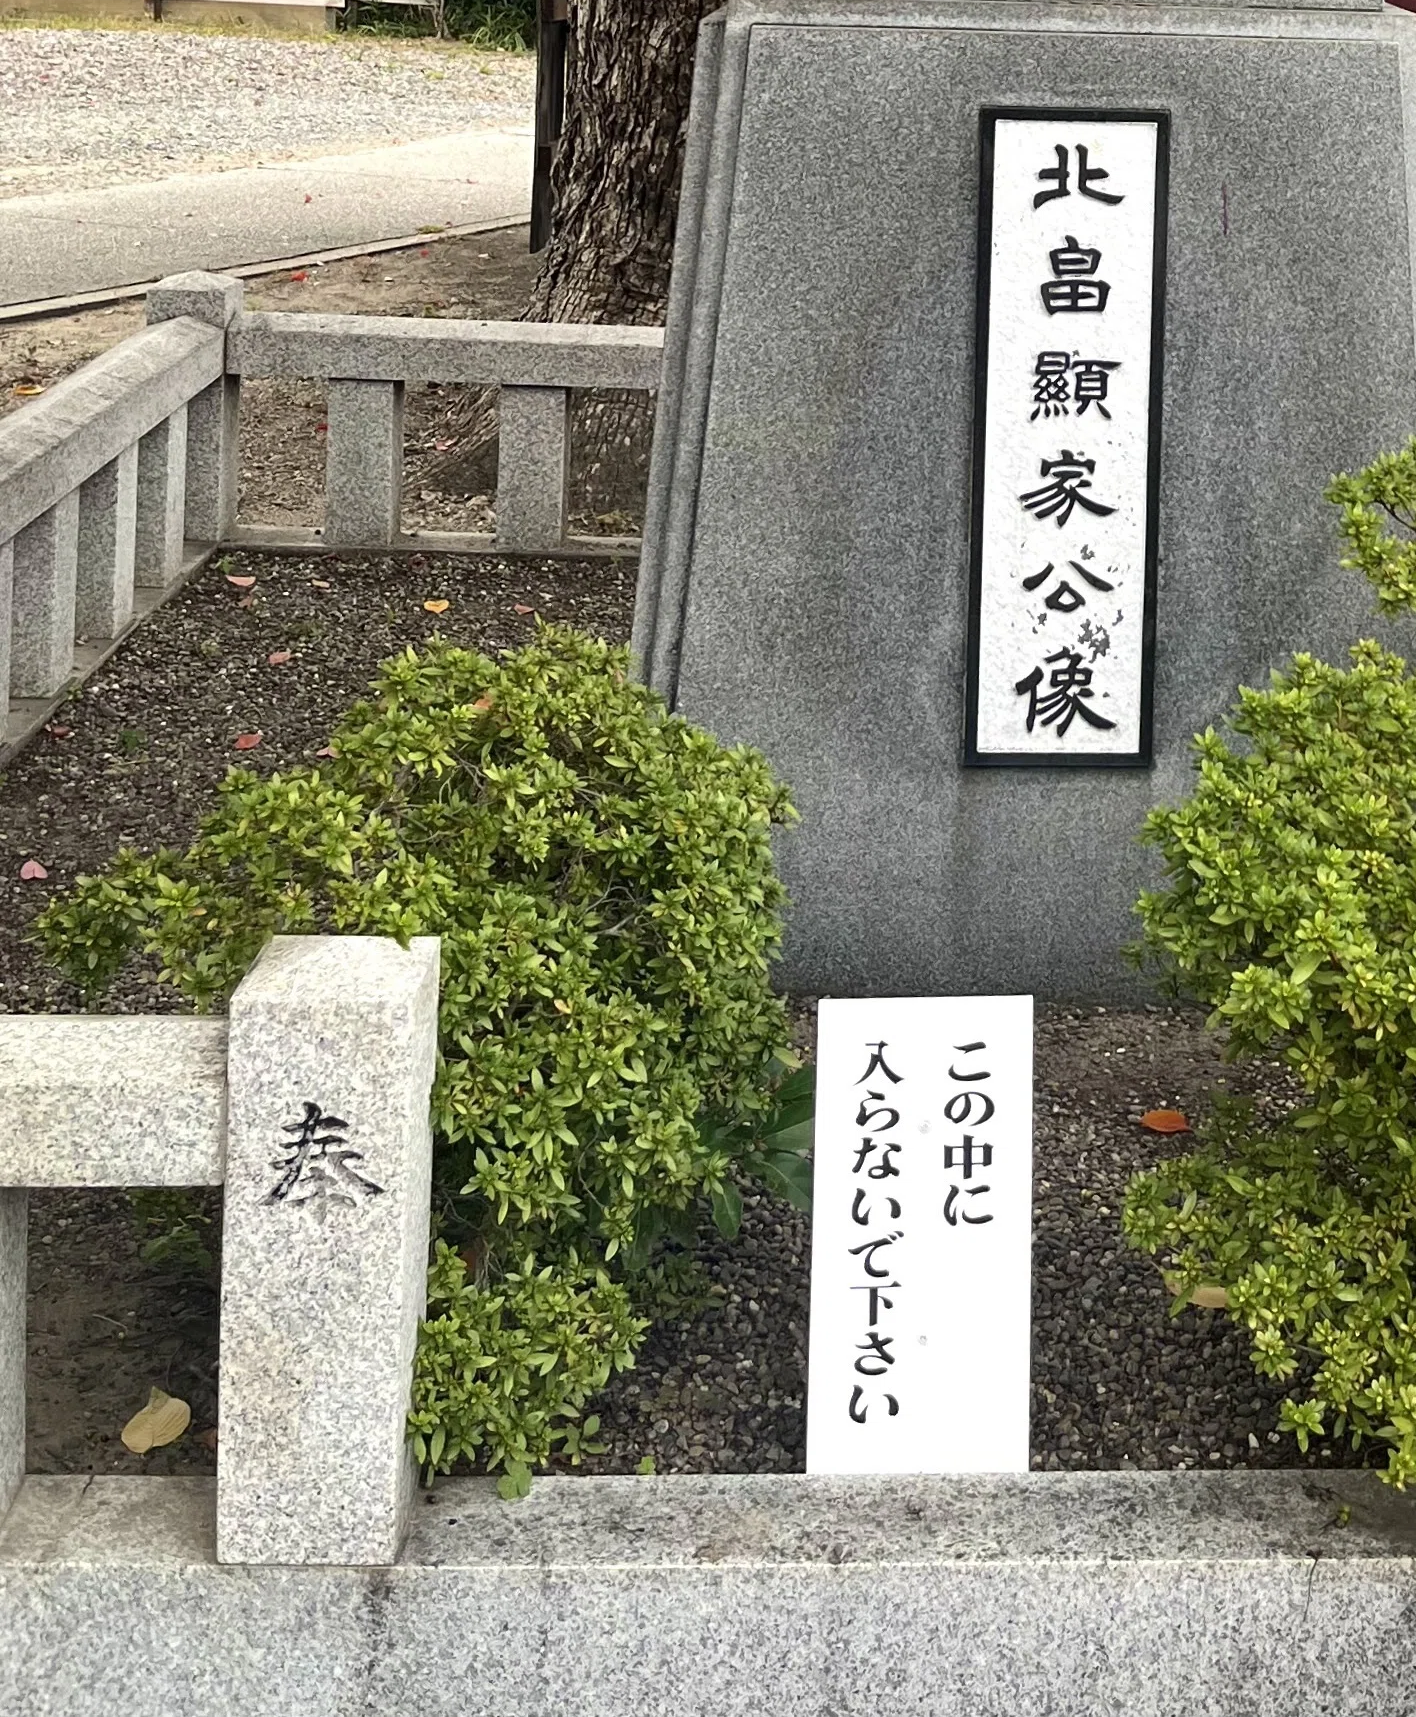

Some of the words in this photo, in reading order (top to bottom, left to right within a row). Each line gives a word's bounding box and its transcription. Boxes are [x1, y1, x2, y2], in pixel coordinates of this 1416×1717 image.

[259, 1100, 386, 1223] 奉
[943, 1040, 996, 1227] この中に
[847, 1039, 905, 1425] 入らないで下さい
